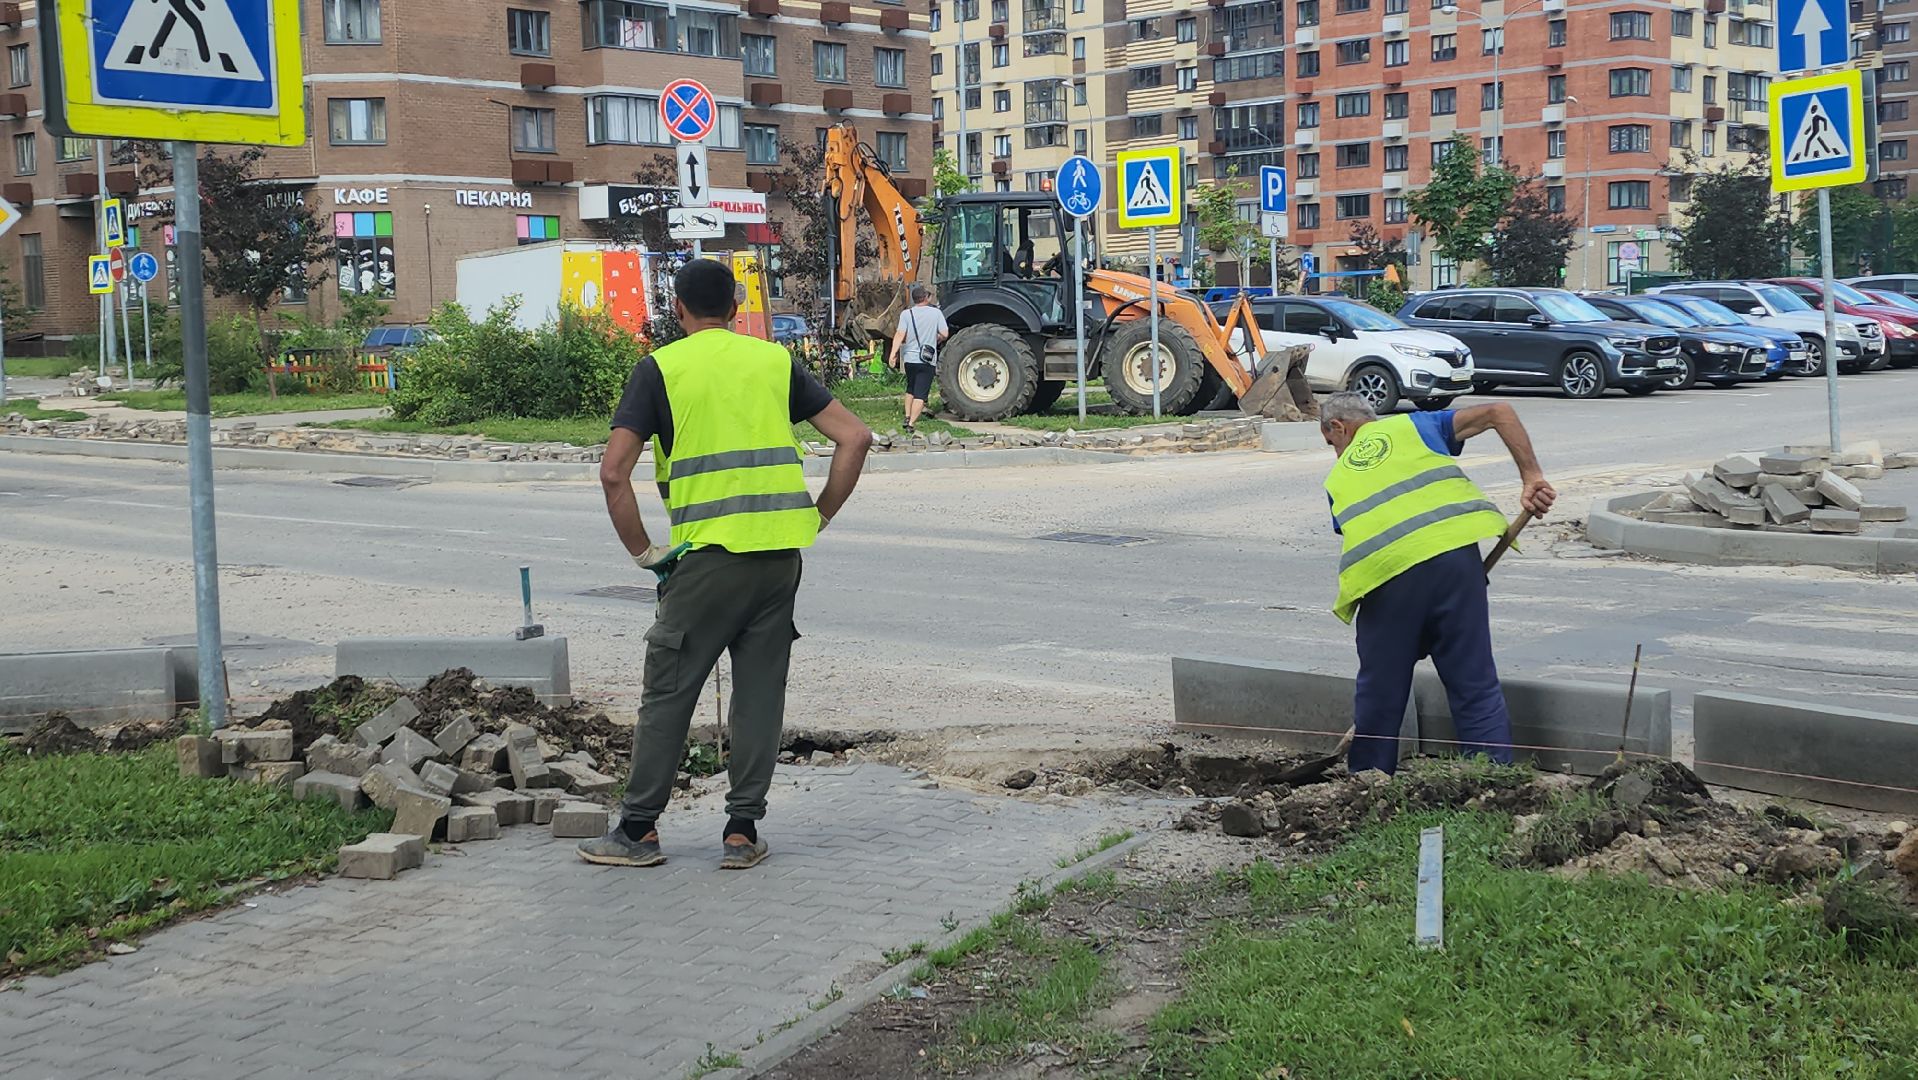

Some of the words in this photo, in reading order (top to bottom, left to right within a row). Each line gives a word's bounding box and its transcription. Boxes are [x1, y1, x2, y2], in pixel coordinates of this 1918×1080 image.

[334, 188, 388, 204] КАФЕ
[1268, 172, 1282, 207] P
[456, 190, 532, 208] ПЕКАРНЯ
